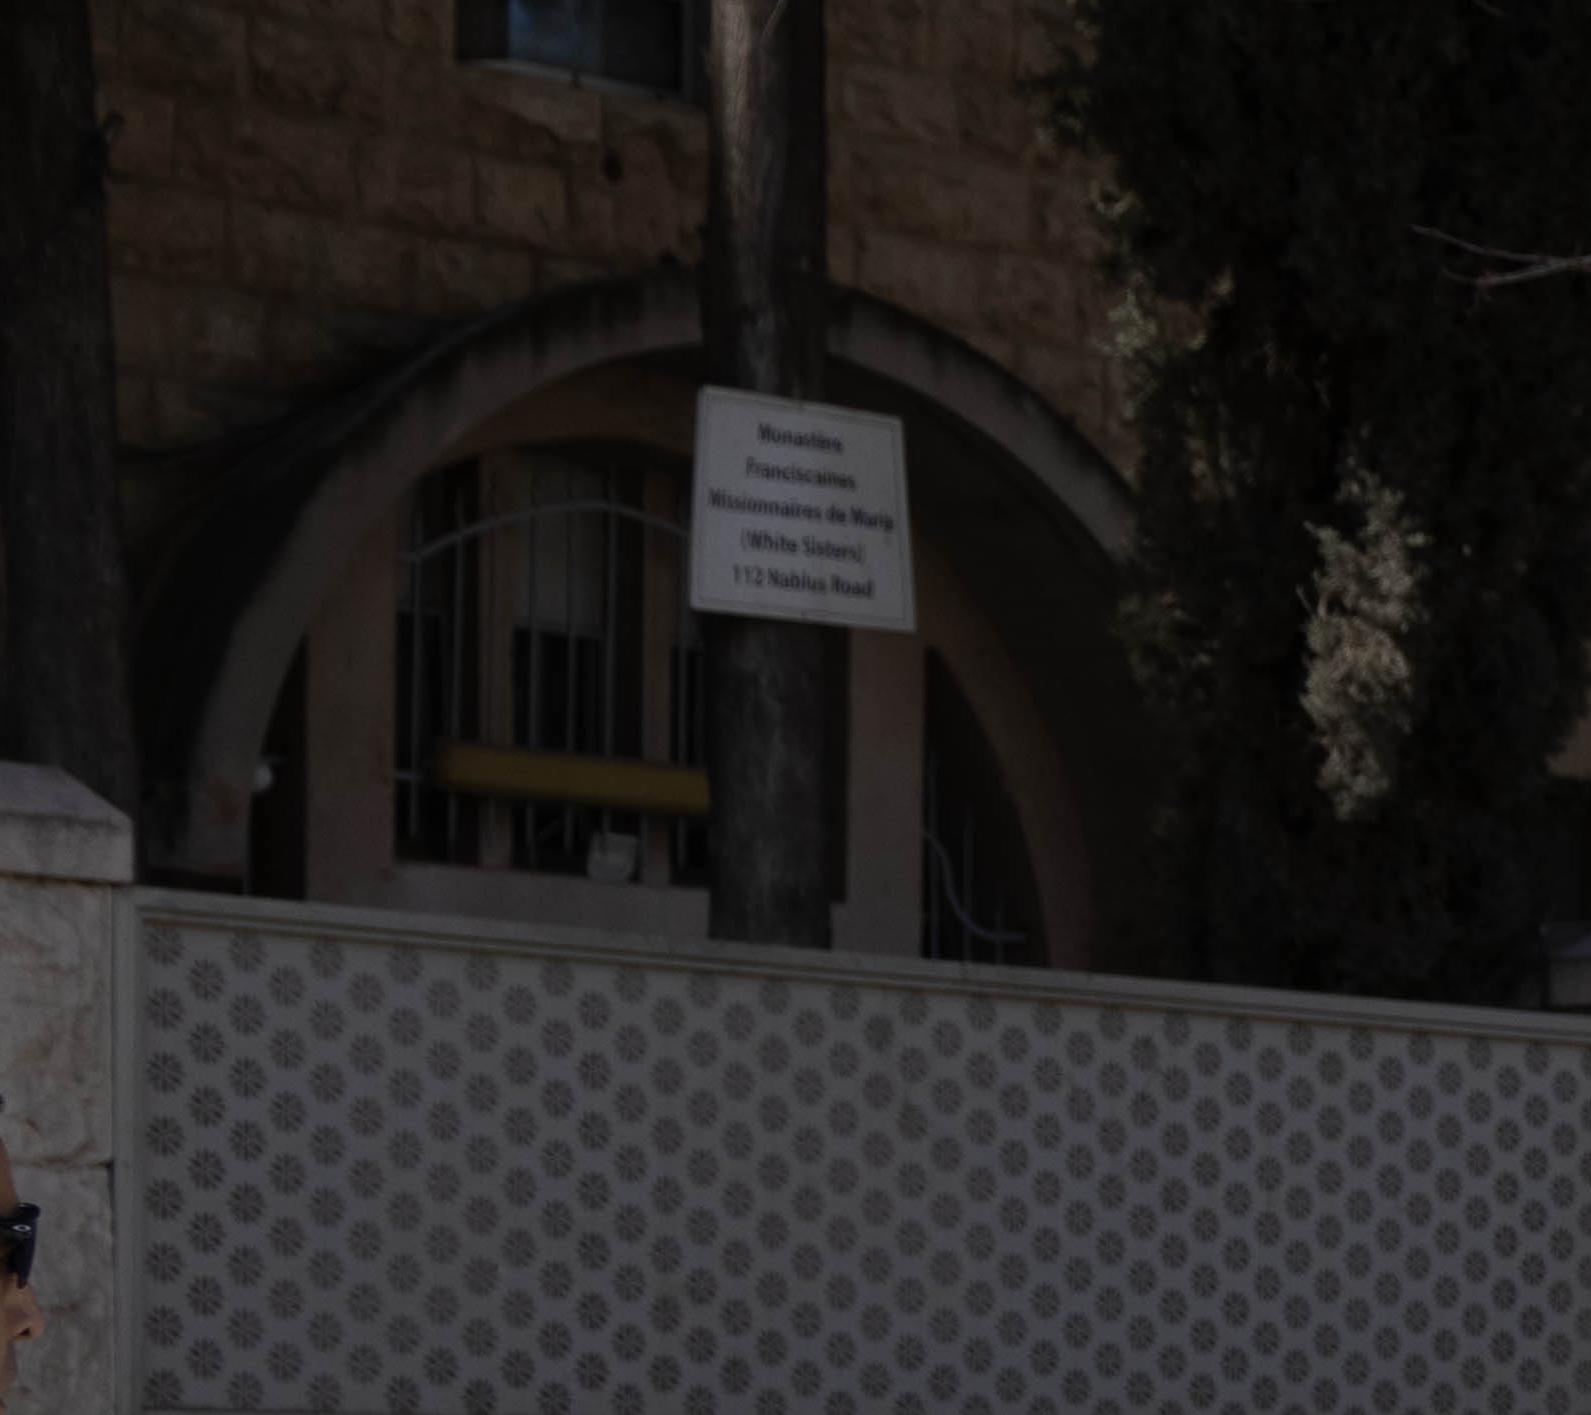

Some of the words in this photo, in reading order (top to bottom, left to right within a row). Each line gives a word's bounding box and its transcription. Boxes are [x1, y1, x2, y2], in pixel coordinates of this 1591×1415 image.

[745, 456, 857, 491] Franciscaines
[707, 488, 824, 523] Missionnaires
[825, 503, 847, 526] de
[849, 505, 895, 532] Marie
[740, 528, 798, 555] (White
[732, 563, 763, 588] 112
[767, 567, 828, 595] Nablus
[829, 572, 876, 599] Road
